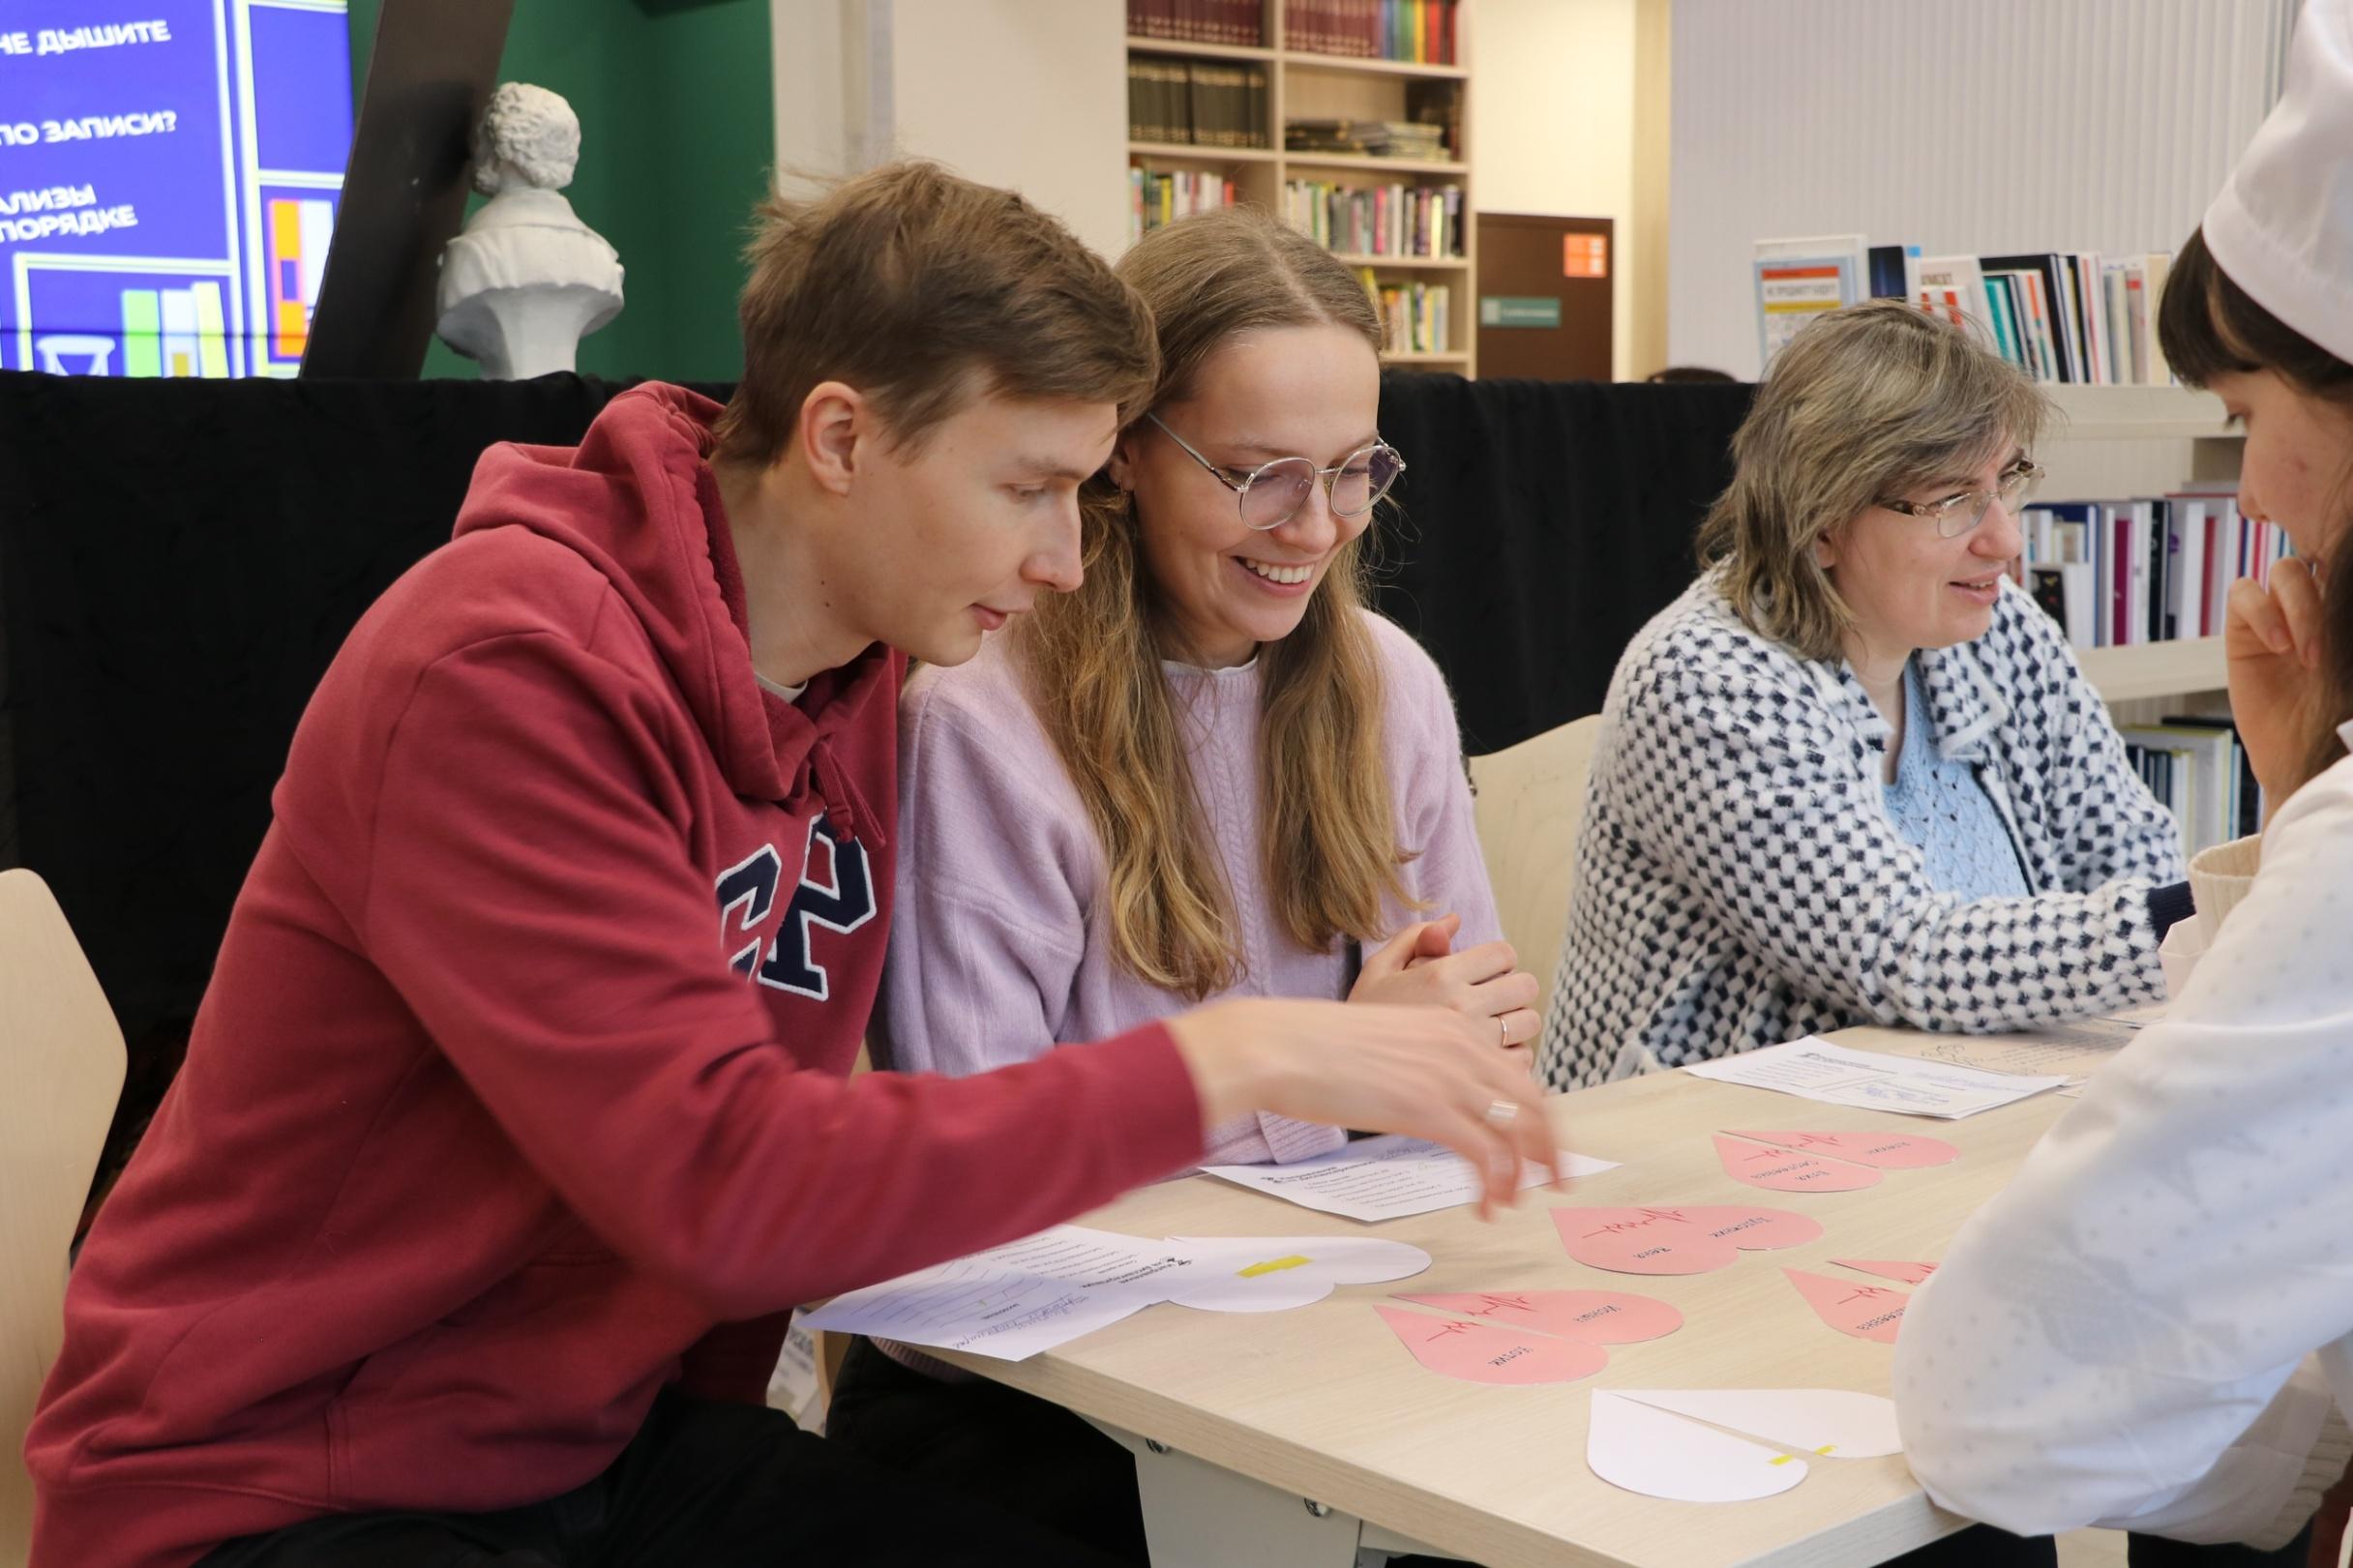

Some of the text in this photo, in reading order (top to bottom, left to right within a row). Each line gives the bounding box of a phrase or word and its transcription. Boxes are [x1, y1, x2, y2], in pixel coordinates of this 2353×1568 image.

[38, 20, 171, 56] ДЫШИТЕ
[0, 111, 177, 146] ПО ЗАПИСИ?
[0, 204, 138, 243] ПОРЯДКЕ
